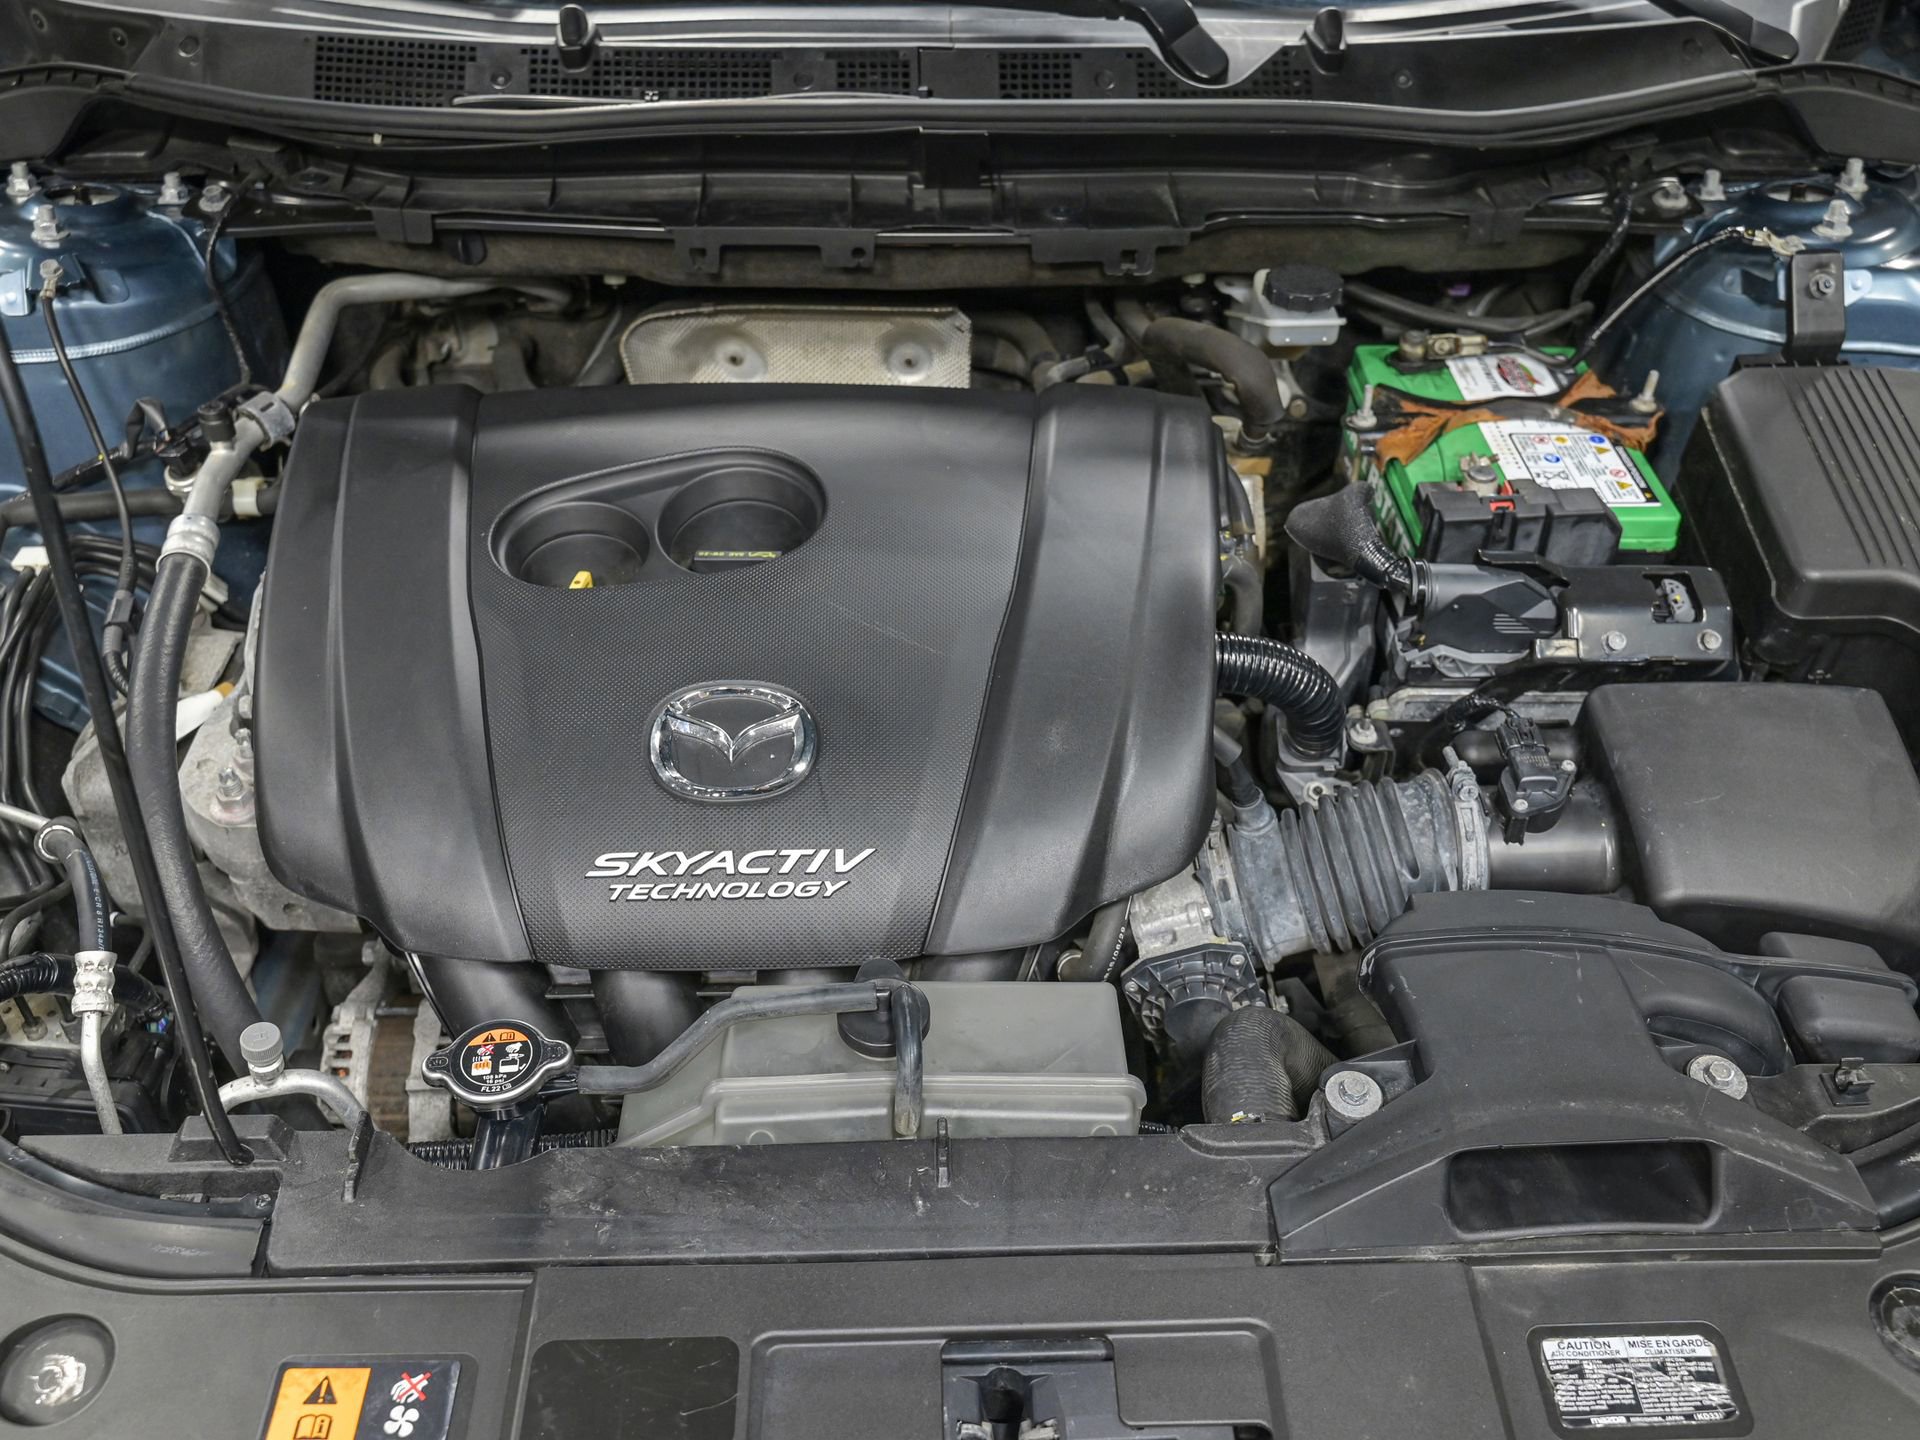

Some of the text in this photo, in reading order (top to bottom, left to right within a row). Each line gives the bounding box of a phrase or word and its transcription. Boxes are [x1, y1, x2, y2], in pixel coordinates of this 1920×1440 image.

[584, 848, 877, 879] SKYACTIV
[608, 880, 851, 902] TECHNOLOGY
[1557, 1340, 1611, 1350] CAUTION
[1627, 1338, 1711, 1349] MISE EN GARDE
[1566, 1349, 1621, 1357] CONDITIONER
[1644, 1348, 1697, 1356] CLIMATISEUR
[1590, 1415, 1627, 1425] mazda
